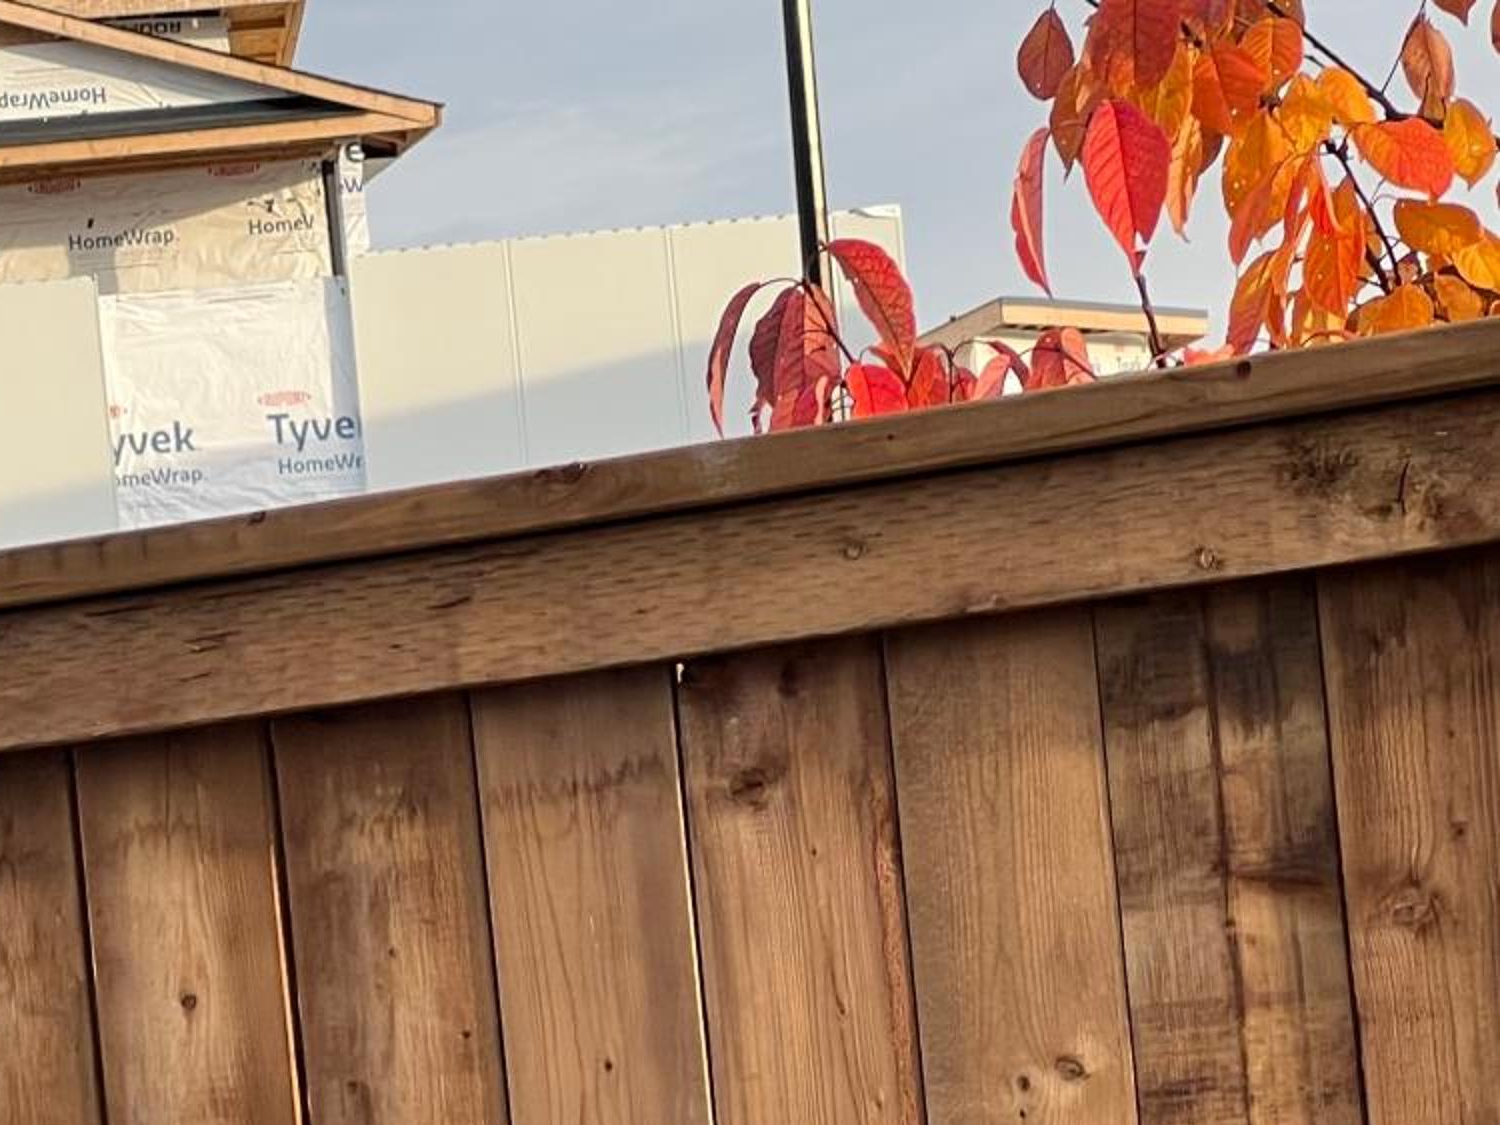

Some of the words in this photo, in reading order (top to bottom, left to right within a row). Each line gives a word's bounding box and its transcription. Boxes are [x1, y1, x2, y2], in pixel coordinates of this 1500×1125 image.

[68, 226, 175, 251] HomeWrap
[113, 420, 197, 466] yvek
[266, 413, 361, 453] Tyve
